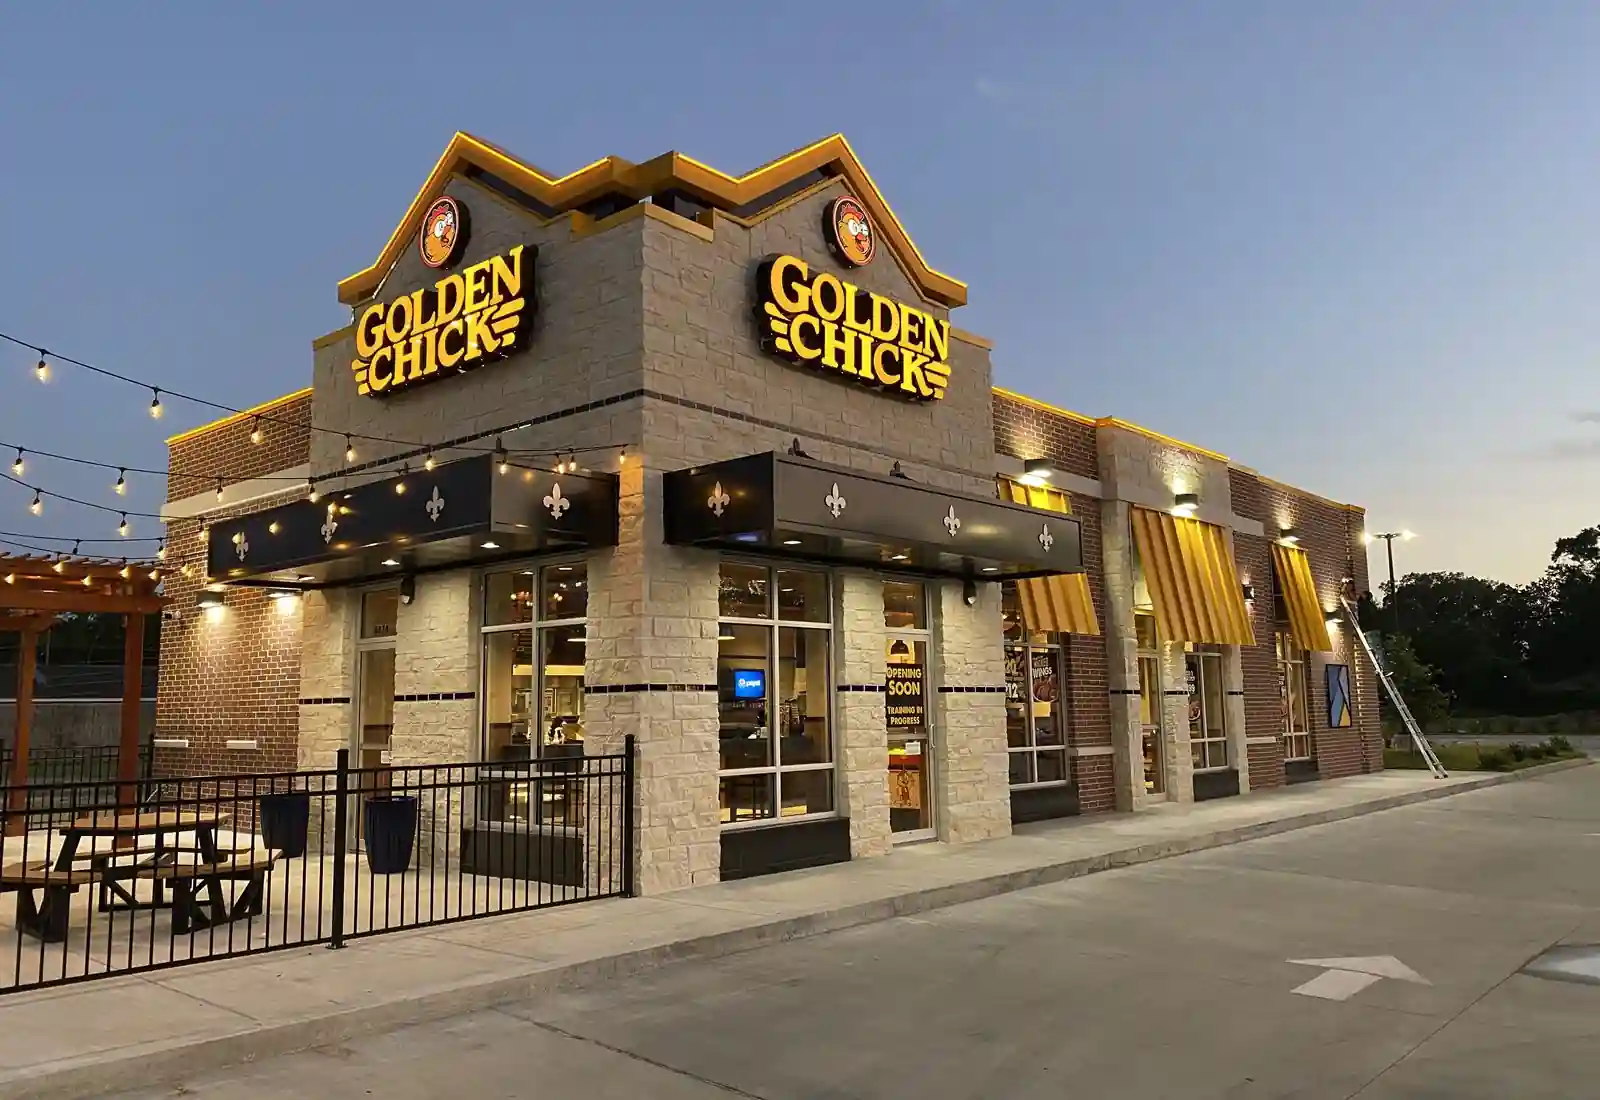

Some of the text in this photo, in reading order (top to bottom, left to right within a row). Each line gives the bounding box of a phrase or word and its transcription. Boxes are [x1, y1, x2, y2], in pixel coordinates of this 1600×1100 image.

[356, 244, 524, 357] GOLDEN
[770, 255, 951, 361] GOLDEN
[368, 305, 501, 391] CHICK
[790, 313, 934, 397] CHICK
[886, 666, 922, 678] OPENING
[888, 680, 921, 695] SOON
[890, 716, 920, 725] PROGRESS
